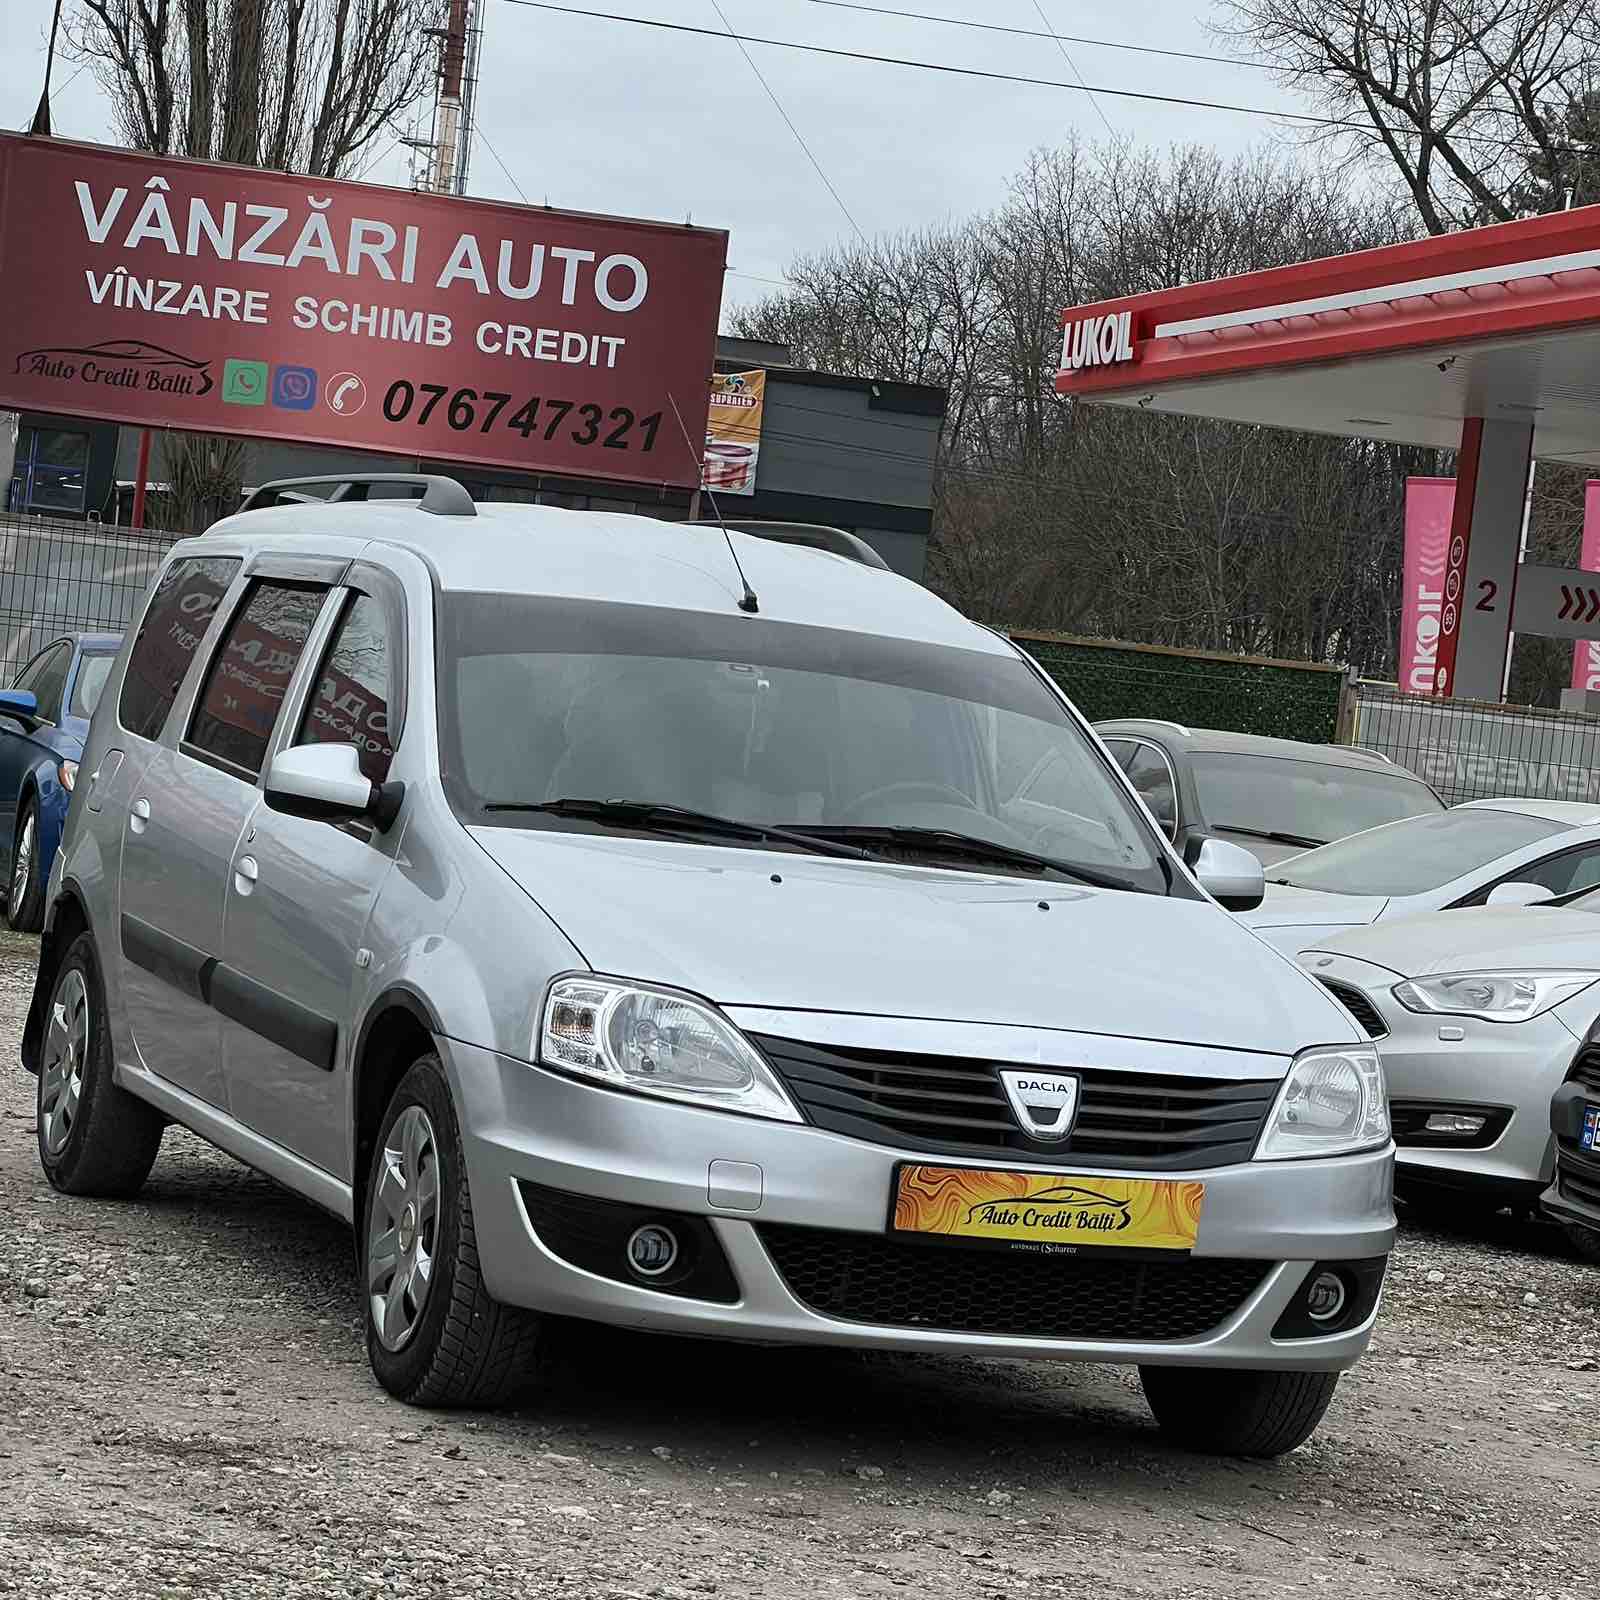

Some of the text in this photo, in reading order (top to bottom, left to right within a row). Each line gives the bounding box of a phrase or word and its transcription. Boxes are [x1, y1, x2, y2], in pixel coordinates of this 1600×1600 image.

[74, 175, 649, 312] VÂNZĂRI AUTO
[86, 265, 626, 368] VÎNZARE SCHIMB CREDIT
[1060, 311, 1134, 370] LUKOIL
[28, 354, 76, 380] Auto
[81, 361, 140, 389] Credit
[383, 380, 663, 452] 076747321
[1475, 580, 1497, 612] 2
[1017, 1080, 1068, 1094] DACIA
[979, 1205, 1020, 1226] Auto
[1022, 1207, 1073, 1229] Credit
